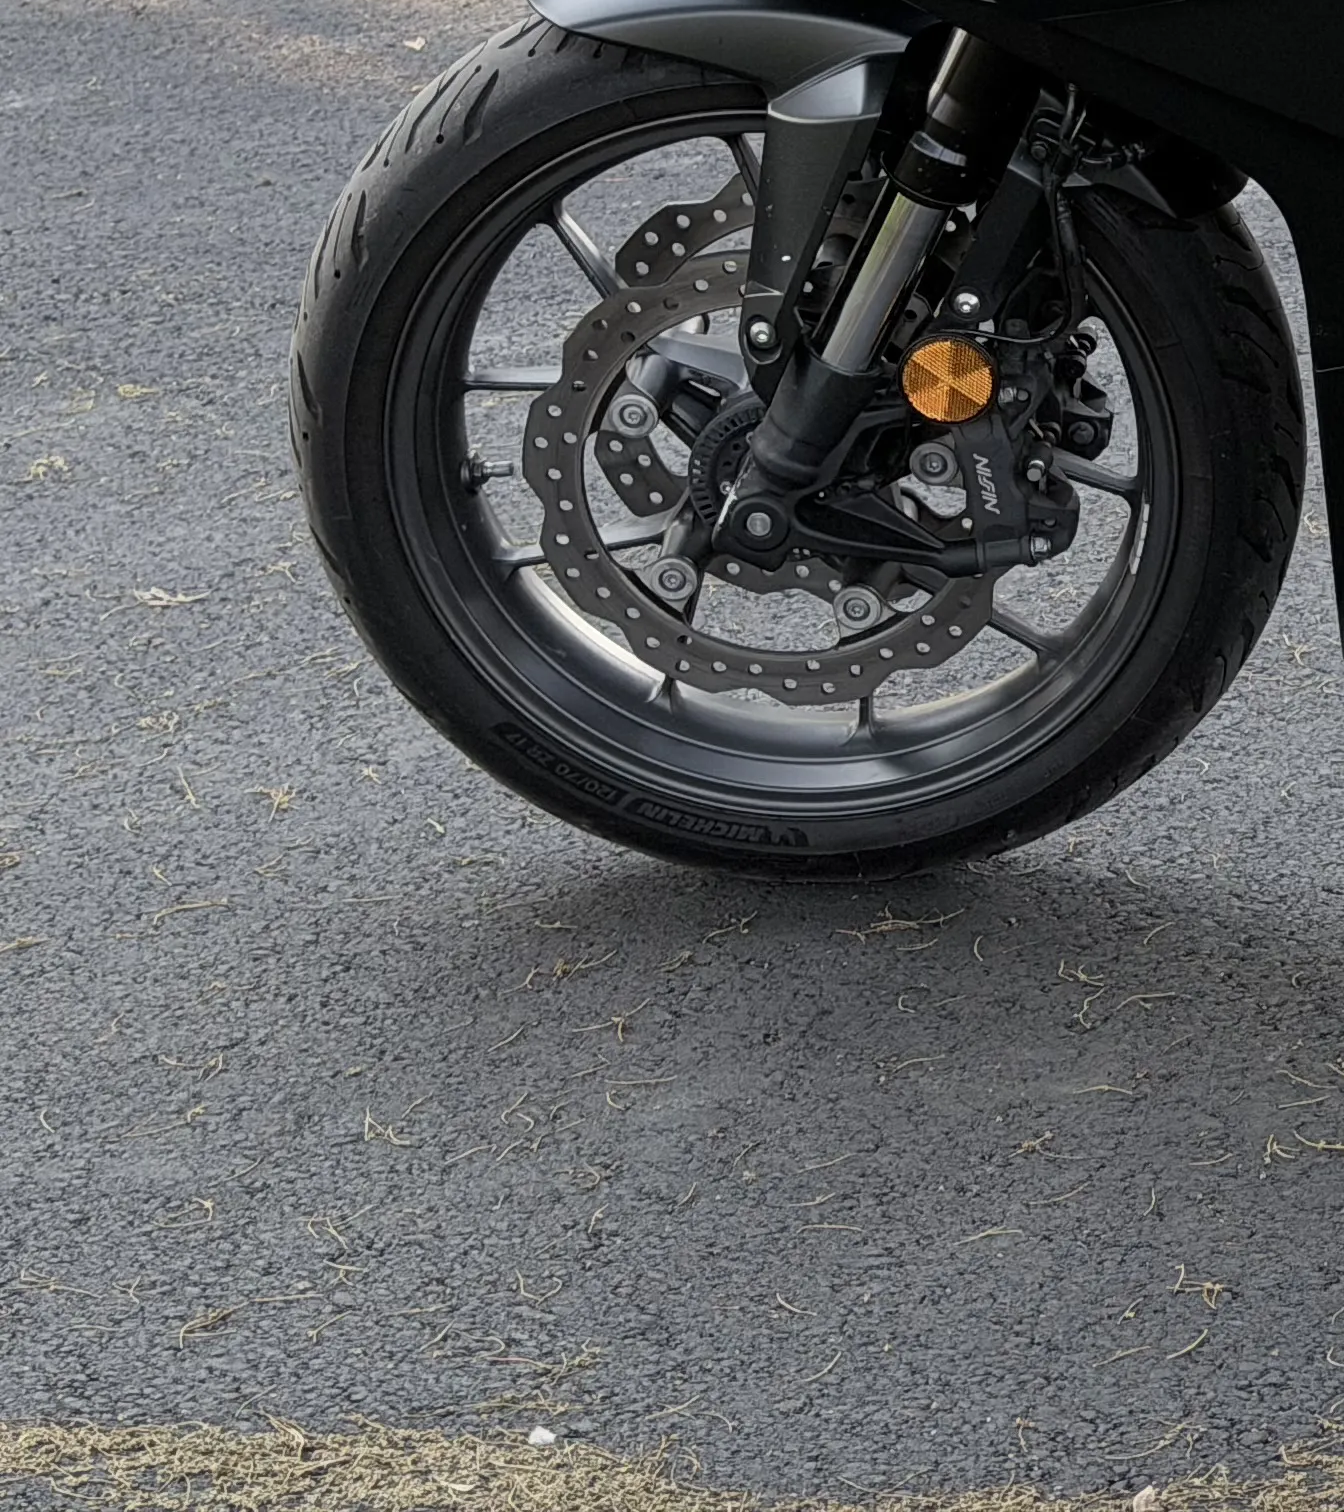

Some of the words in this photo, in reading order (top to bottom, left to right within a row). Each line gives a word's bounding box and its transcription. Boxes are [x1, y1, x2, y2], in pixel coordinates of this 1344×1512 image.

[972, 453, 1001, 515] NISSIN
[504, 731, 528, 749] 17
[526, 743, 553, 767] ZR
[554, 762, 622, 803] 120/70
[635, 800, 766, 844] MICHELIN
